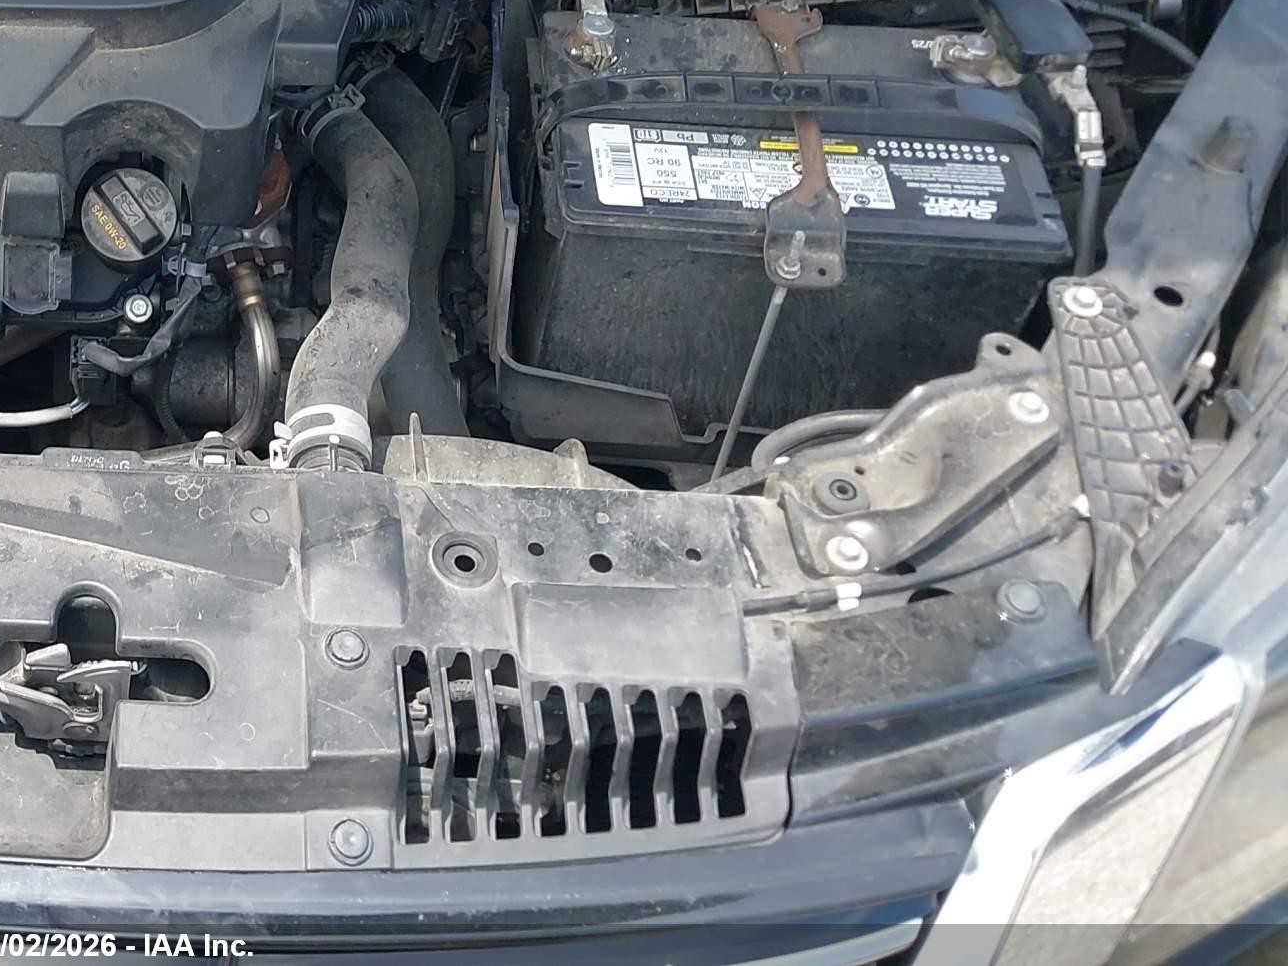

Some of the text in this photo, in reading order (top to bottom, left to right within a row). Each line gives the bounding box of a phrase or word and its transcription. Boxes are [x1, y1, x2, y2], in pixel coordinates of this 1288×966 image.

[647, 157, 664, 166] RC
[923, 195, 998, 213] START
[924, 207, 993, 221] SUPER
[91, 204, 127, 249] SAE 0W-20
